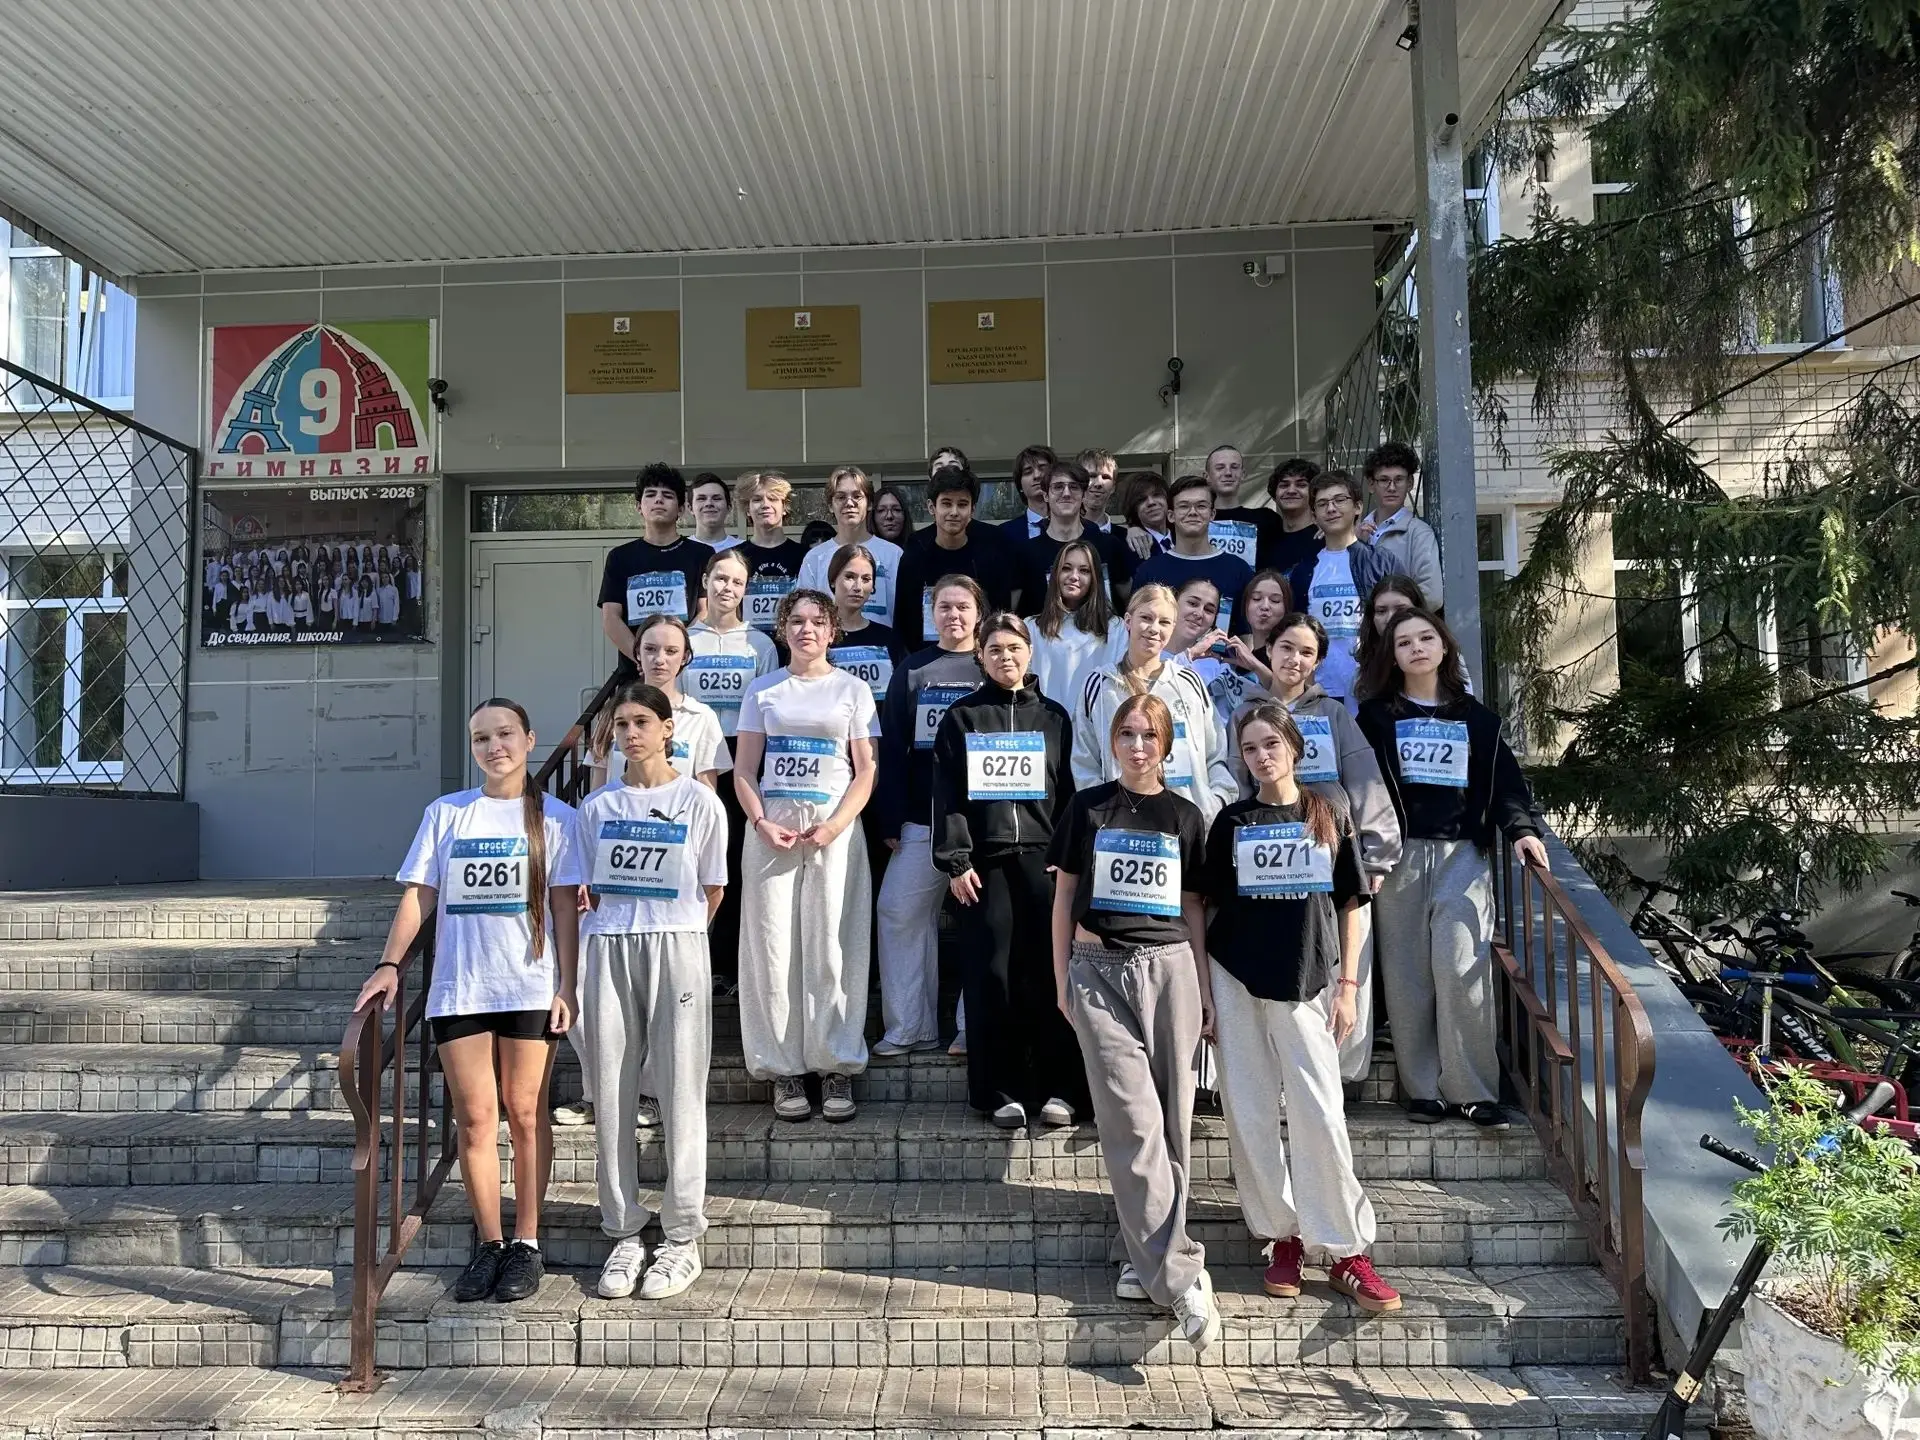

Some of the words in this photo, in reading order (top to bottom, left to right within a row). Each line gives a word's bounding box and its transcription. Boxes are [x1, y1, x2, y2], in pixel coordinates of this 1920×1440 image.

[299, 368, 341, 436] 9
[210, 456, 429, 477] ГИМНАЗИЯ
[310, 487, 369, 501] ВЫПУСК
[380, 486, 415, 499] 2026
[1209, 538, 1246, 554] 6269
[637, 590, 674, 608] 6267
[752, 597, 779, 614] 627
[1323, 600, 1364, 617] 6254
[699, 672, 742, 690] 6259
[839, 663, 880, 682] 260
[1400, 741, 1453, 765] 6272
[774, 757, 820, 777] 6254
[982, 756, 1032, 777] 6276
[631, 826, 658, 834] КРОСС
[1269, 827, 1297, 836] КРОСС
[479, 842, 507, 850] КРОСС
[1129, 839, 1157, 849] КРОСС
[610, 844, 668, 871] 6277
[1253, 843, 1311, 868] 6271
[463, 862, 520, 887] 6261
[1110, 858, 1168, 887] 6256
